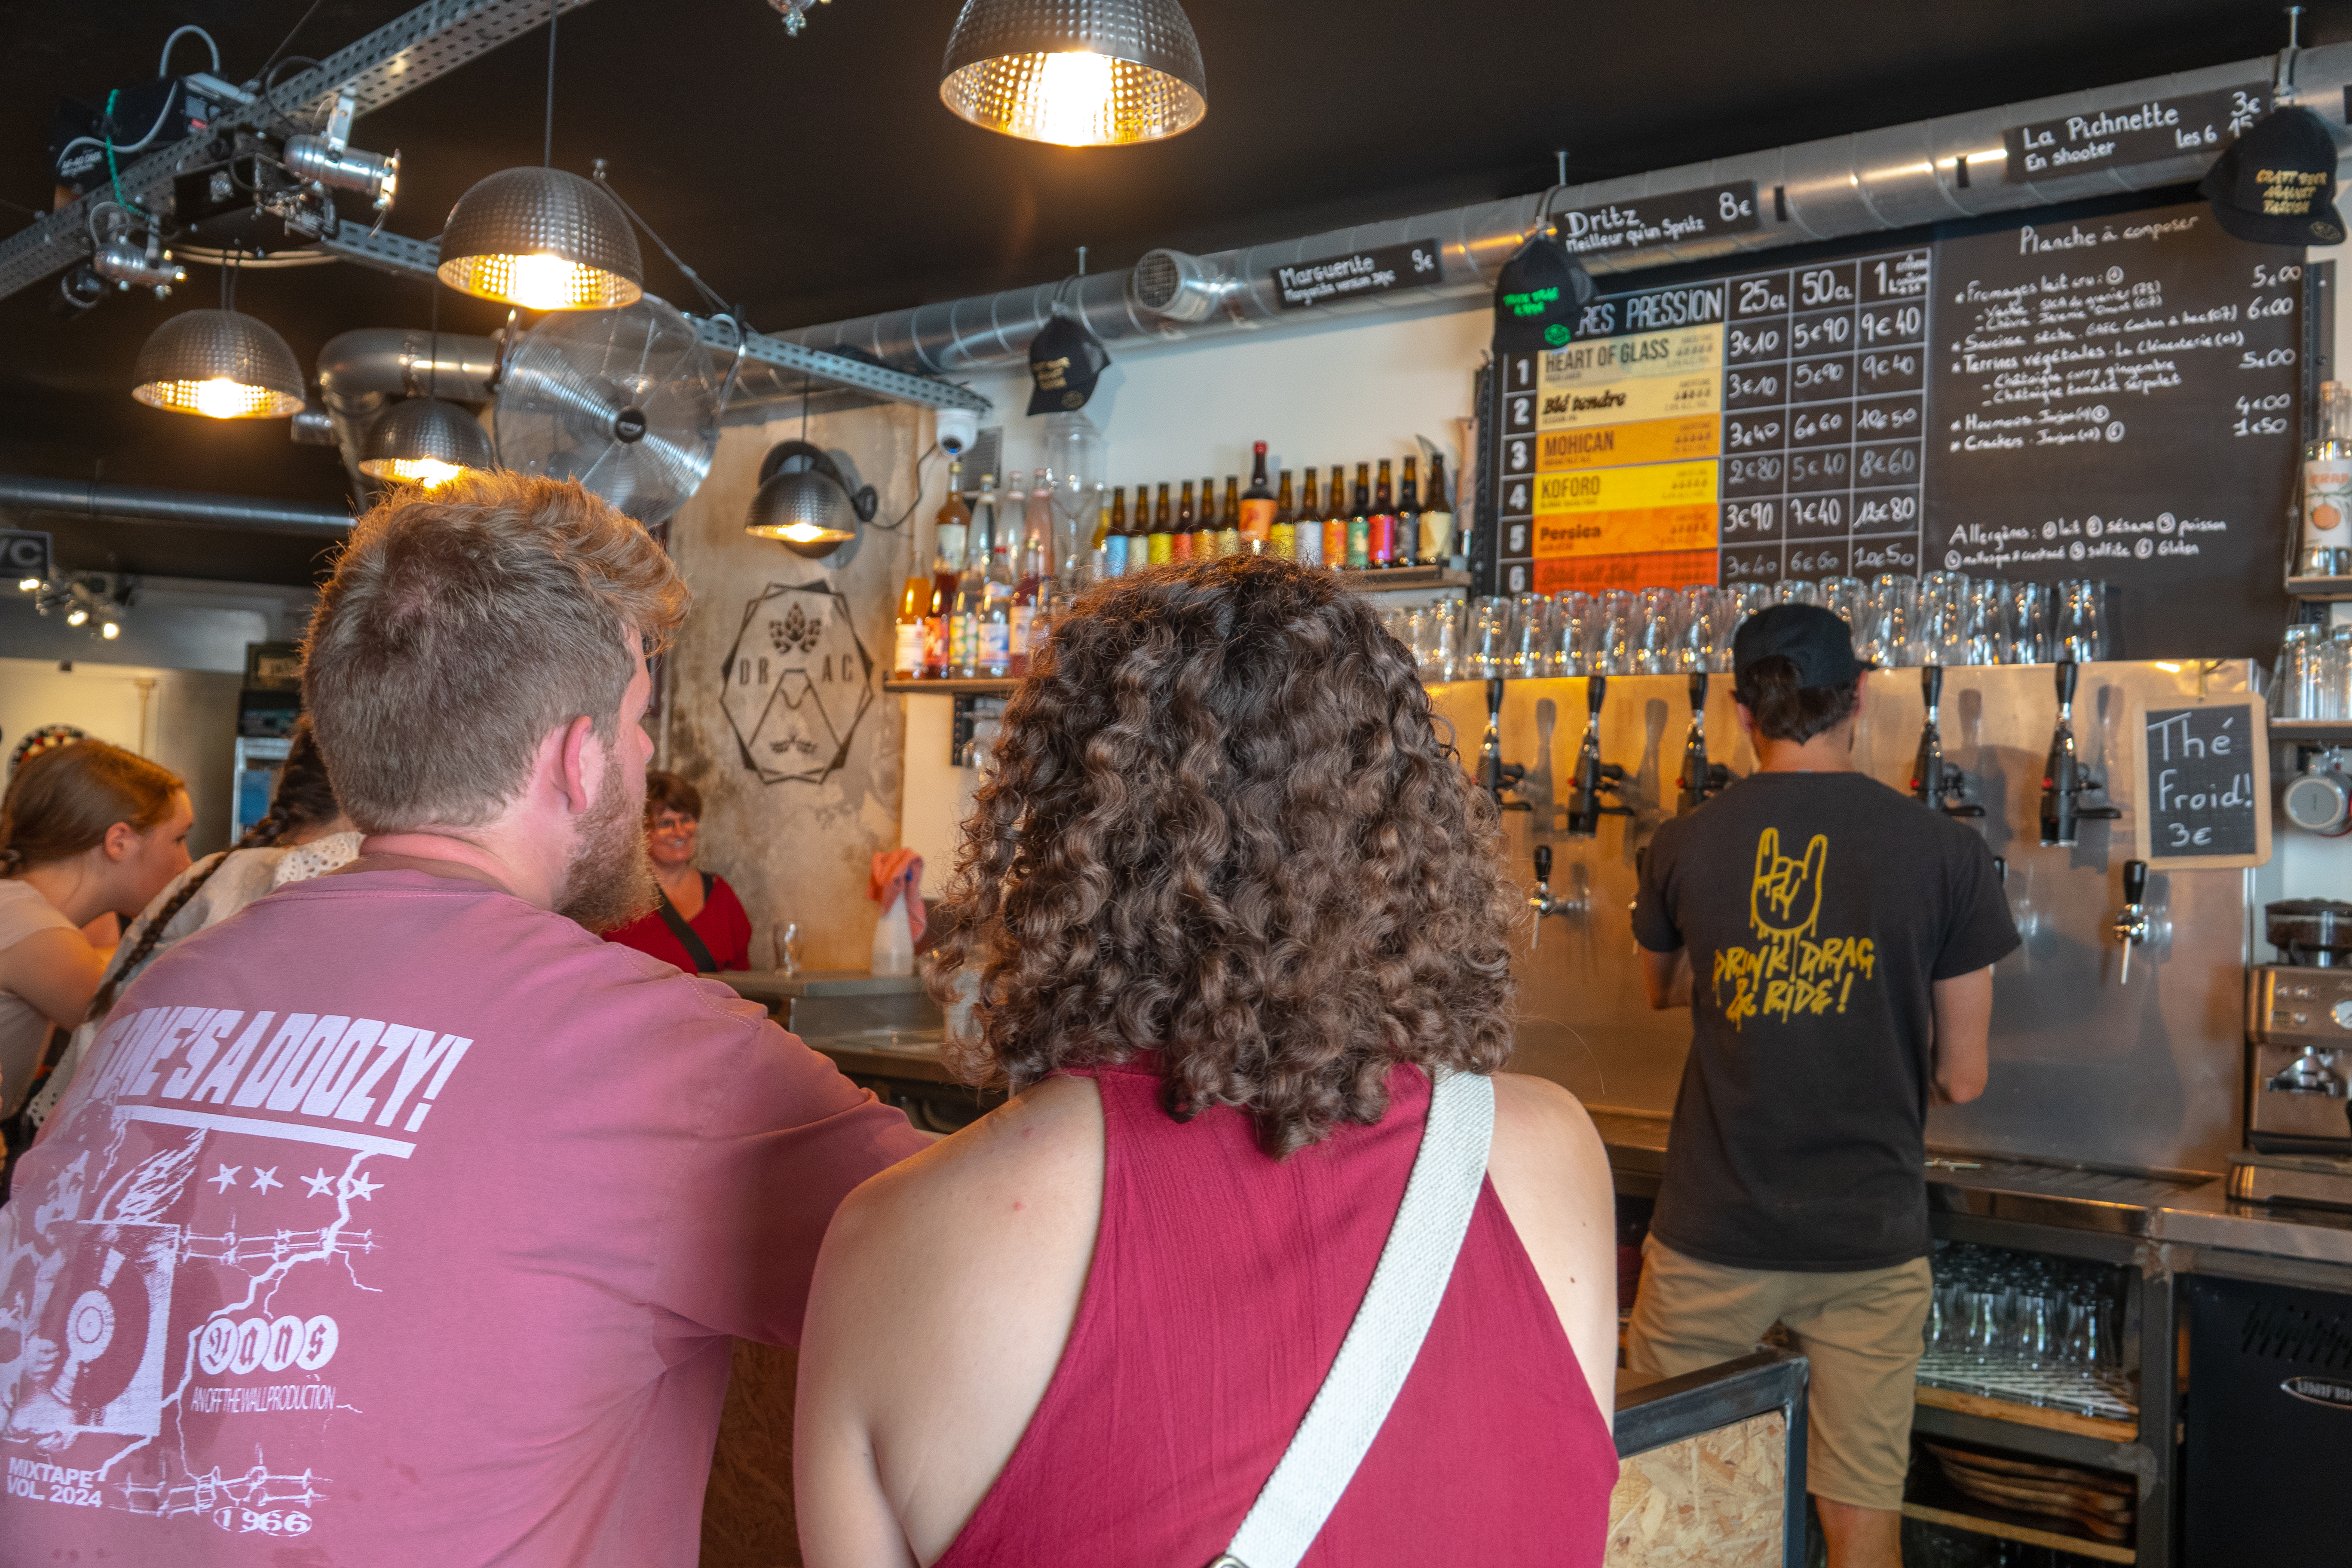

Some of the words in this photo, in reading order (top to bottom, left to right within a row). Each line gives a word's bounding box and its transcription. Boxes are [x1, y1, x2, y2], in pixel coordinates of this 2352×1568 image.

[2023, 127, 2056, 150] La
[2065, 101, 2180, 141] Pichnette
[2230, 91, 2261, 117] 3€
[2024, 153, 2048, 172] En
[2052, 140, 2116, 166] shooter
[2175, 128, 2201, 149] les
[2204, 126, 2217, 144] 6
[1565, 206, 1638, 239] Dritz
[1719, 192, 1752, 222] 8€
[1565, 230, 1623, 254] Meilleur
[1662, 215, 1706, 241] Spritz
[2020, 225, 2097, 255] Planche
[2122, 216, 2199, 241] composer
[1626, 287, 1723, 330] PRESSION
[1794, 316, 1850, 350] 5€90
[1547, 346, 1589, 374] HEART
[1597, 344, 1617, 366] OF
[1620, 337, 1670, 364] GLASS
[1517, 359, 1530, 386] 1
[1513, 398, 1530, 426] 2
[1511, 441, 1528, 470] 3
[1544, 430, 1616, 458] MOHICAN
[1509, 484, 1528, 510] 4
[1540, 475, 1602, 499] KOFORO
[1509, 524, 1526, 552] 5
[1540, 524, 1602, 541] Persica
[1509, 565, 1526, 593] 6
[2147, 711, 2234, 762] Thé
[2168, 822, 2213, 848] 3€
[8, 1457, 93, 1488] MIXTAPE
[49, 1484, 103, 1508] 2024
[218, 1508, 310, 1534] 1966
